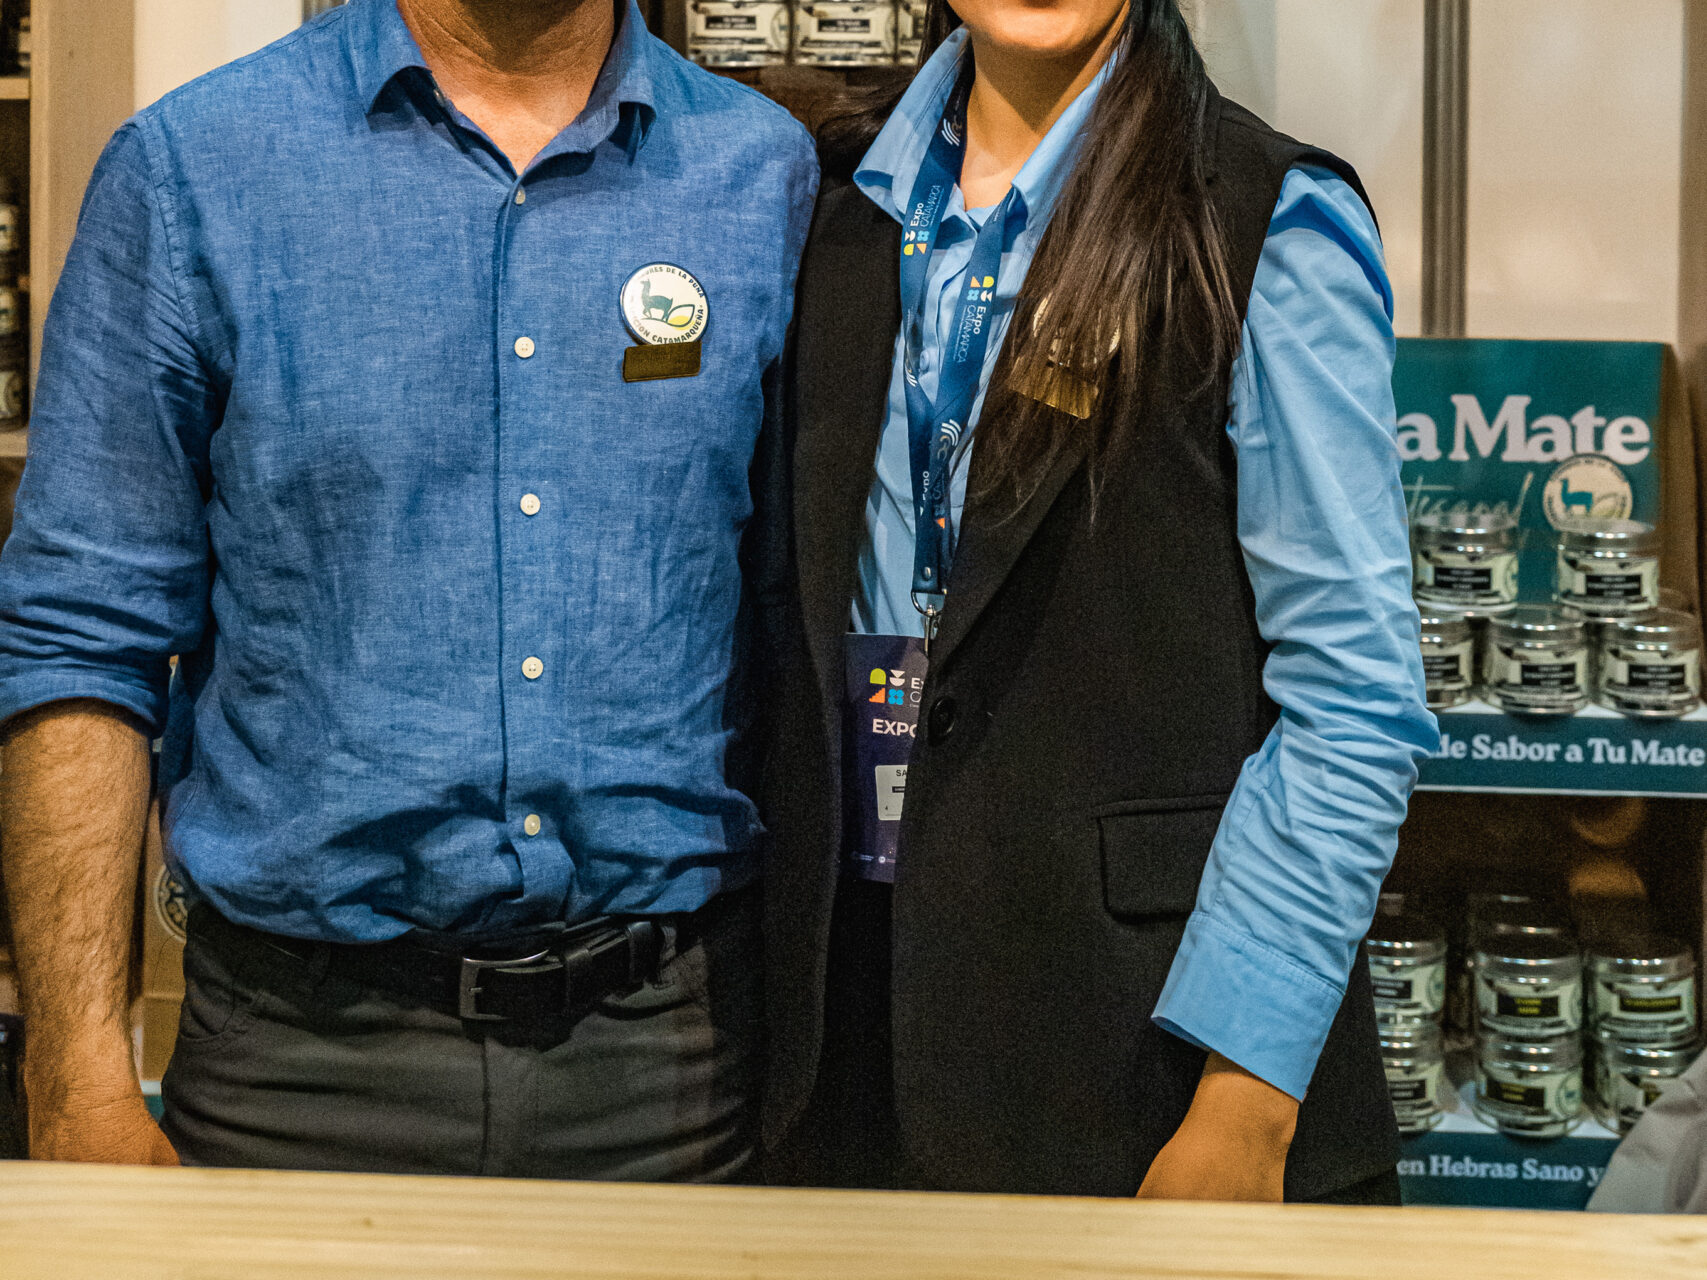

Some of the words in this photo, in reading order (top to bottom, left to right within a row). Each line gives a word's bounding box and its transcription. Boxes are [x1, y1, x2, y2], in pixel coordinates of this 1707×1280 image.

[910, 202, 924, 227] Expo
[666, 266, 676, 274] DE
[678, 271, 687, 280] LA
[688, 278, 705, 298] PUNA
[972, 305, 987, 336] Expo
[1449, 394, 1652, 466] Mate
[1471, 733, 1561, 762] Sabor
[1564, 743, 1585, 763] a
[1587, 737, 1626, 764] Tu
[1630, 738, 1706, 767] Mate
[1396, 1158, 1425, 1176] en
[1429, 1154, 1518, 1179] Hebras
[1522, 1158, 1585, 1182] Sano
